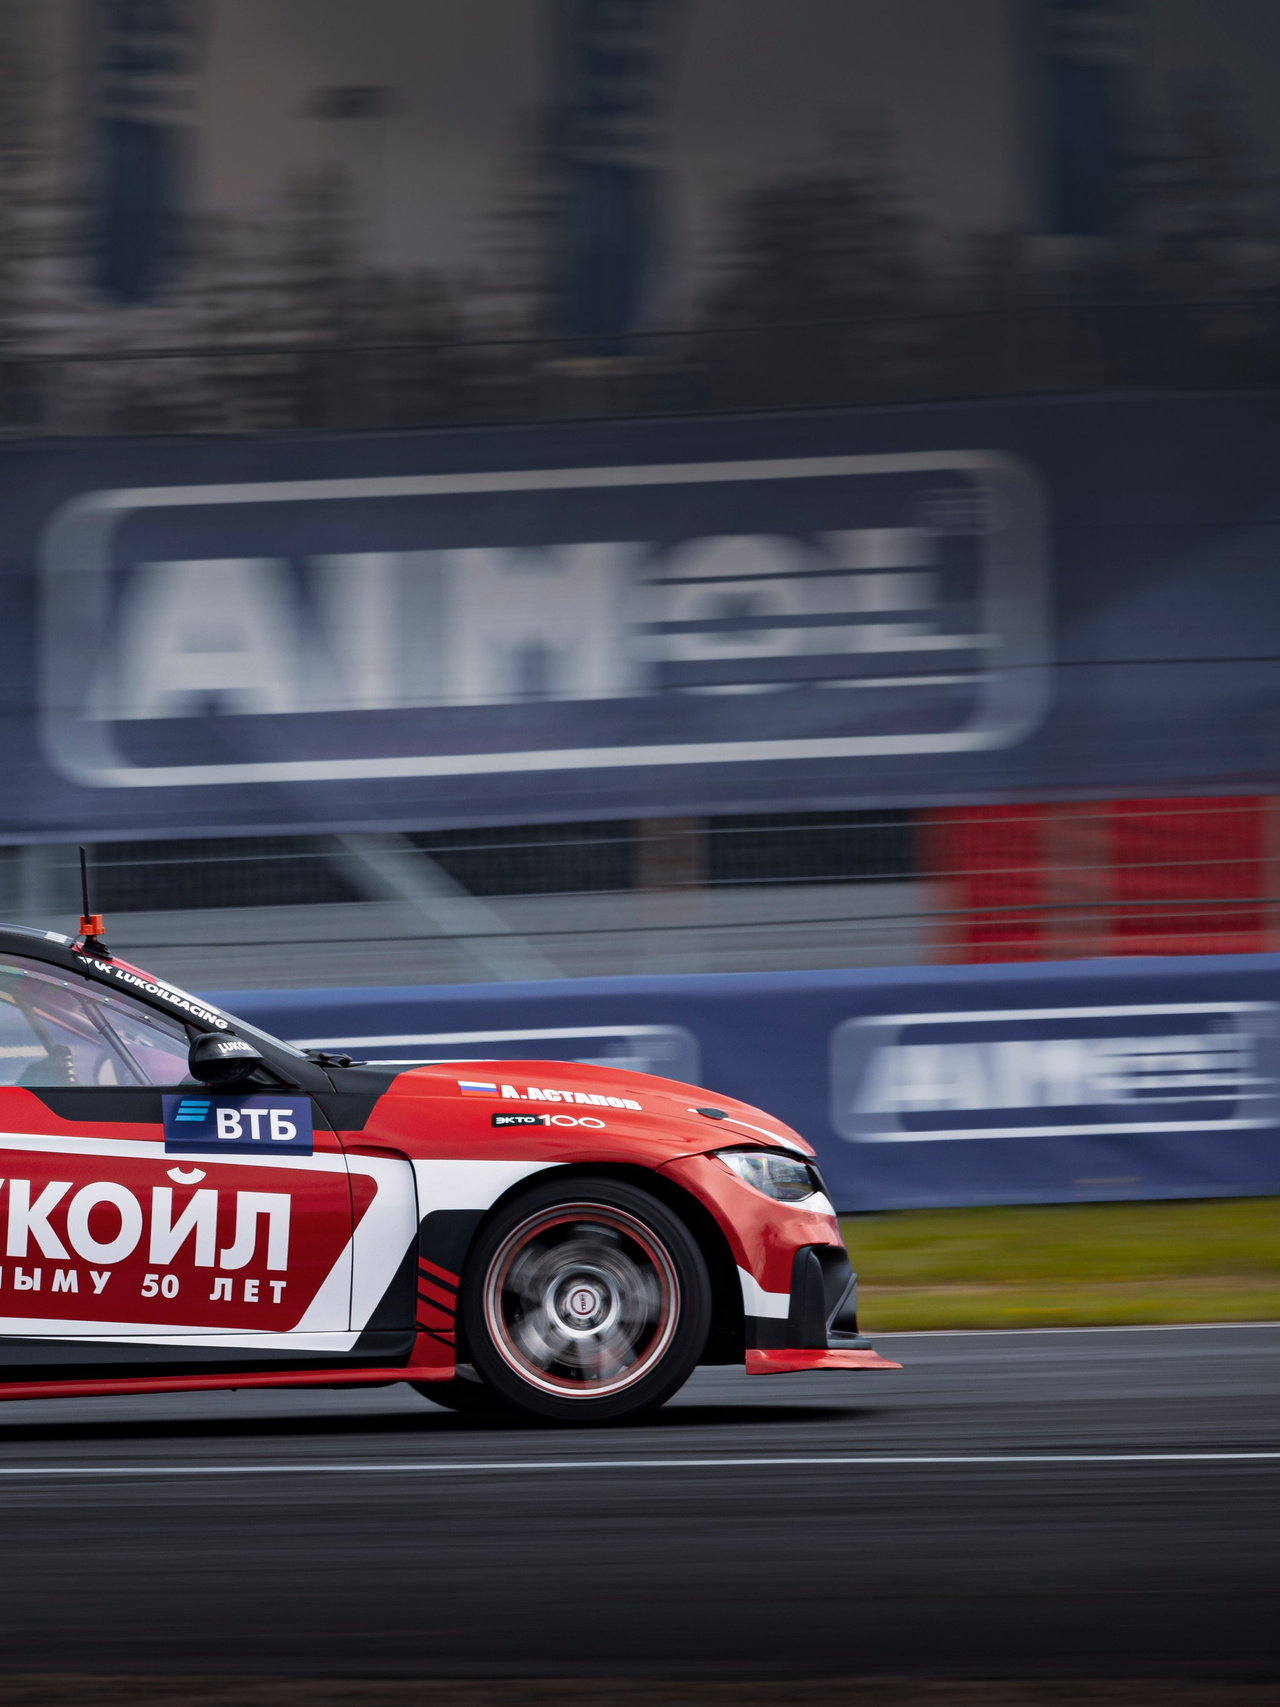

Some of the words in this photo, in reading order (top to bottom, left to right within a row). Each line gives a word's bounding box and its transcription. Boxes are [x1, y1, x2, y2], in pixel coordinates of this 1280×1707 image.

[115, 969, 229, 1030] LUKOILRACING
[500, 1084, 643, 1111] А.АСТАПОВ
[216, 1108, 297, 1141] ВТБ
[141, 1273, 180, 1298] 50
[209, 1276, 287, 1304] ЛЕТ
